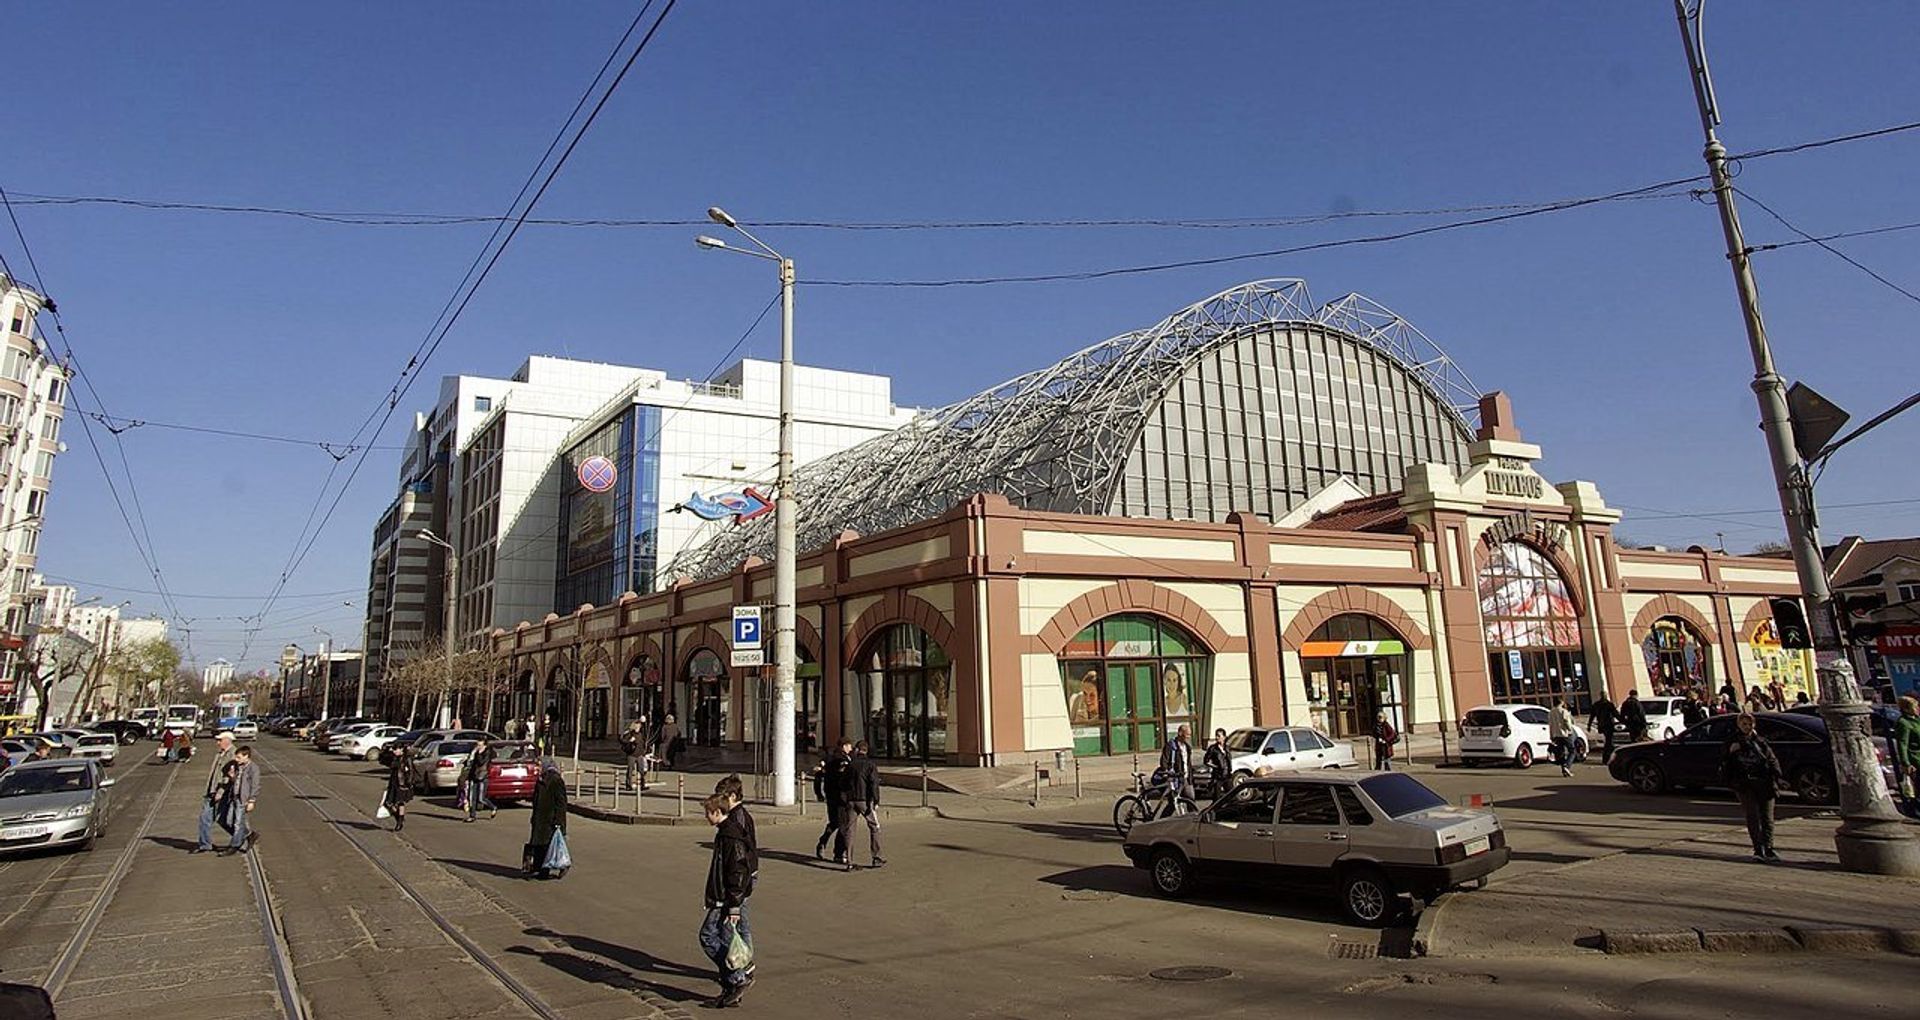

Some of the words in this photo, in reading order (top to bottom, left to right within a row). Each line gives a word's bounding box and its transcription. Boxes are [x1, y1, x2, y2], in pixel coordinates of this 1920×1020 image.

[1483, 470, 1544, 499] ПРИВОЗ
[741, 622, 755, 640] P
[1893, 663, 1917, 674] ТУТ
